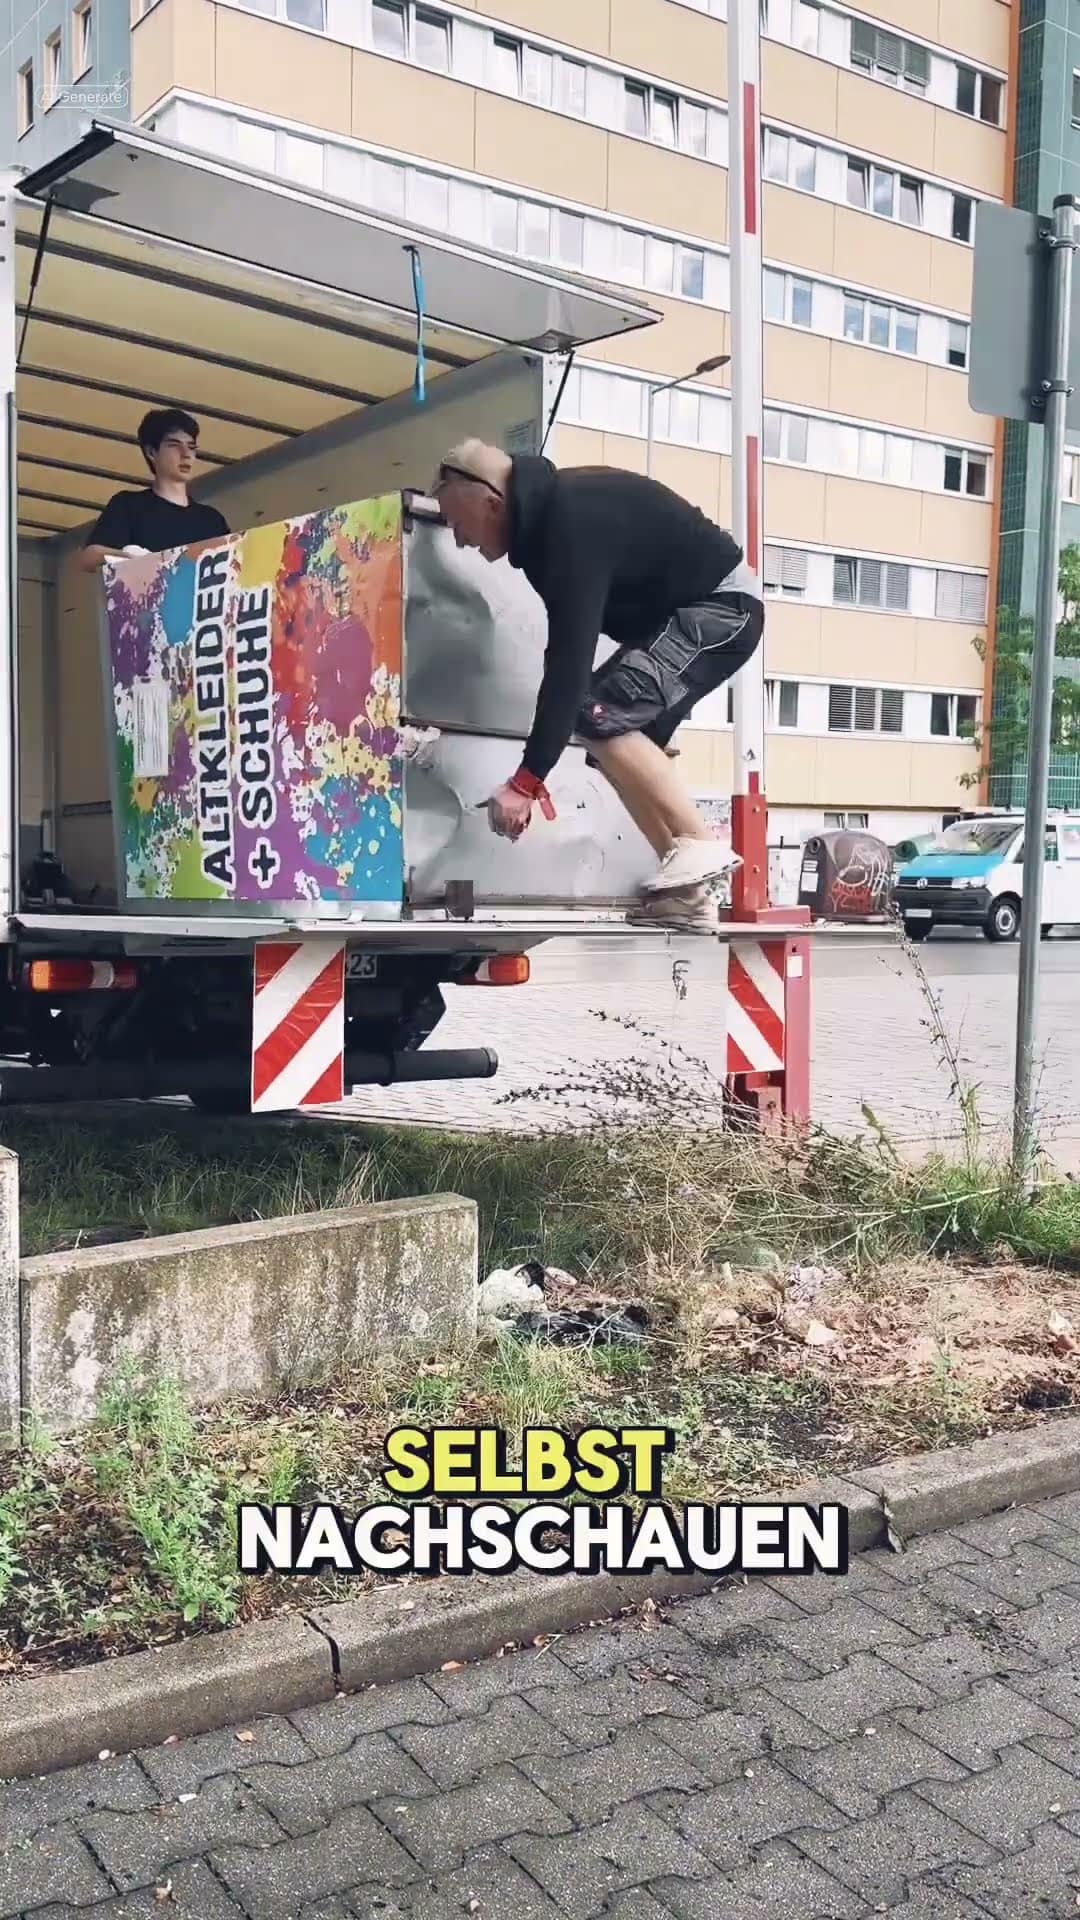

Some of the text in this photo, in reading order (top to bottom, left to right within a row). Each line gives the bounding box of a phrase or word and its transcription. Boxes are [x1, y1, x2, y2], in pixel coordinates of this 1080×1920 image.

[196, 550, 234, 885] ALTKLEIDER
[236, 587, 274, 823] SCHUHE
[345, 953, 376, 976] 23
